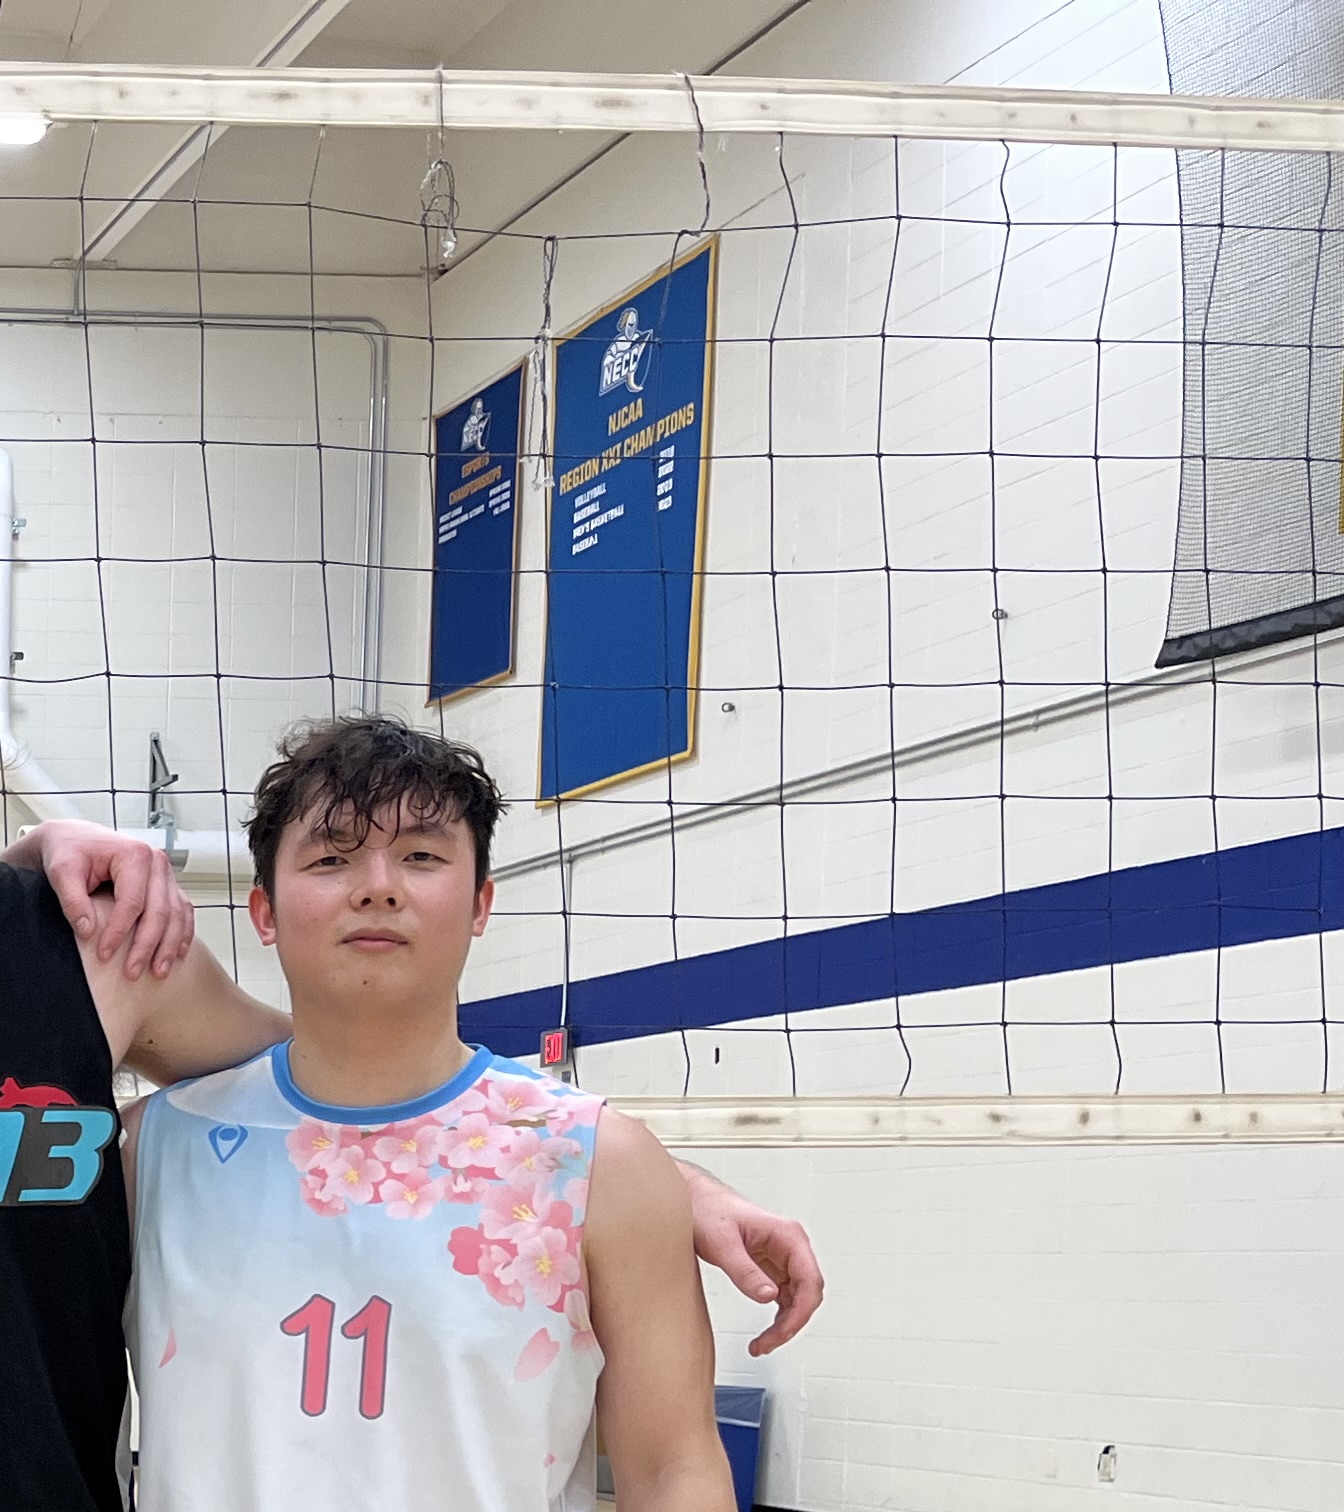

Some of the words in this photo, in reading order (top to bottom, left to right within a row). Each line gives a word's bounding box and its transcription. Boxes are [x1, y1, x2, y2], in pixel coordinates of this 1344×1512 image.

[603, 349, 639, 388] NECC
[559, 456, 600, 496] REGION
[601, 442, 623, 473] XXI
[623, 401, 695, 458] CHAMPIONS
[608, 397, 643, 437] NJCAA
[280, 1293, 393, 1420] 11
